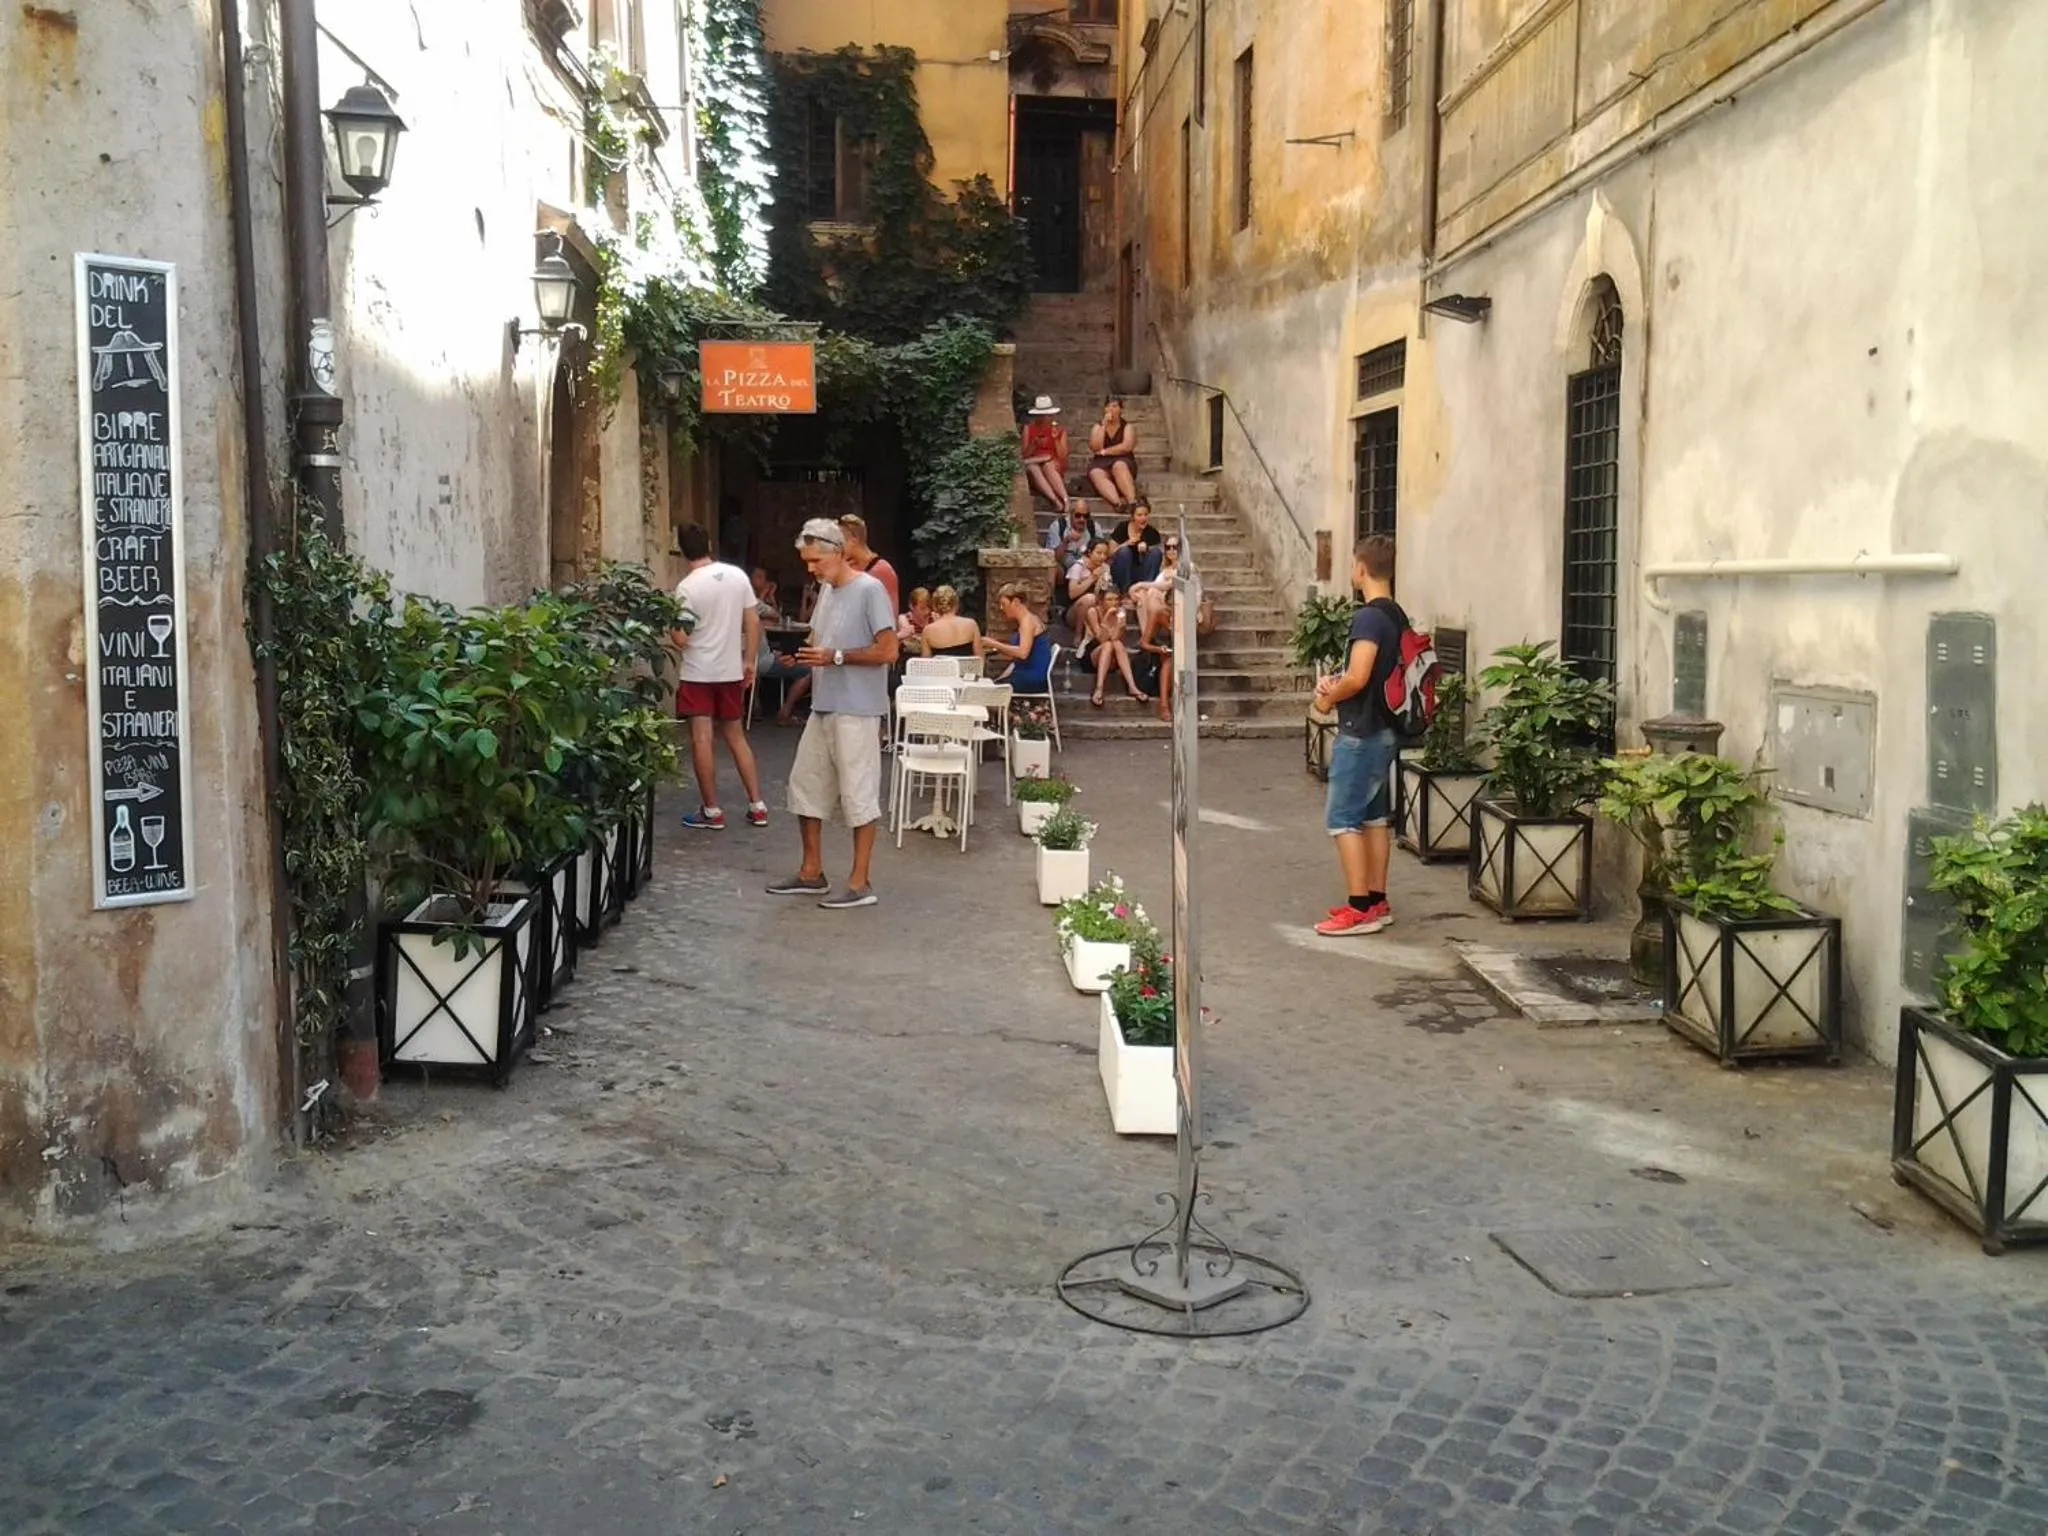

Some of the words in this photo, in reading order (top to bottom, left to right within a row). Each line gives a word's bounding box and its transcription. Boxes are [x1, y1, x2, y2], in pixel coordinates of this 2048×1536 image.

[90, 271, 149, 304] DRINK
[91, 303, 133, 329] DEL
[723, 369, 788, 387] PIZZA
[718, 388, 792, 410] TEATRO
[94, 411, 162, 441] BIRRE
[95, 472, 168, 498] ITALIANE
[95, 497, 105, 523] E
[96, 535, 162, 561] CRAFT
[100, 565, 160, 593] BEER
[99, 631, 145, 658] VINI
[103, 663, 173, 688] ITALIANI
[124, 690, 137, 710] E
[102, 710, 179, 738] STRANIERI
